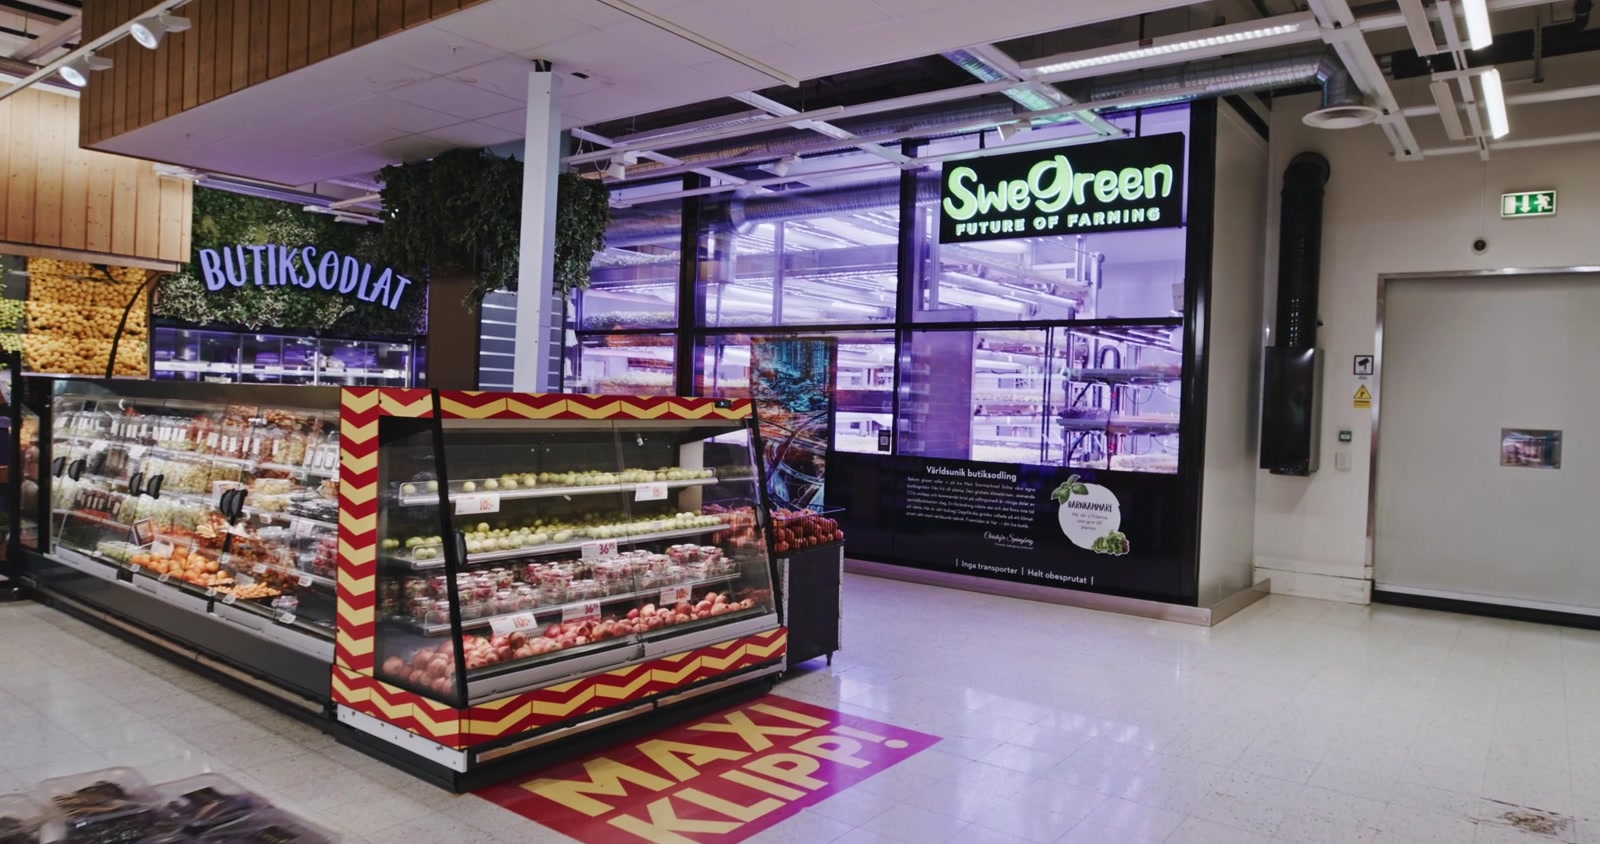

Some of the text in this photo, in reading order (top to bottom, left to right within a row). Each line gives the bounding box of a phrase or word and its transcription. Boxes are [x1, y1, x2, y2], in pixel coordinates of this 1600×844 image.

[955, 207, 1161, 236] FUTURE OF FARMING
[200, 244, 412, 310] BUTIKSODLAT
[926, 465, 1017, 483] Världsunik butiksodling
[1068, 500, 1113, 512] BARNKAMMARE
[961, 560, 977, 570] Inga
[978, 563, 1018, 575] transporter
[1027, 569, 1043, 578] Helt
[1045, 572, 1087, 584] obesprutat
[519, 703, 830, 817] MAXI
[606, 724, 908, 844] KLIPP!
